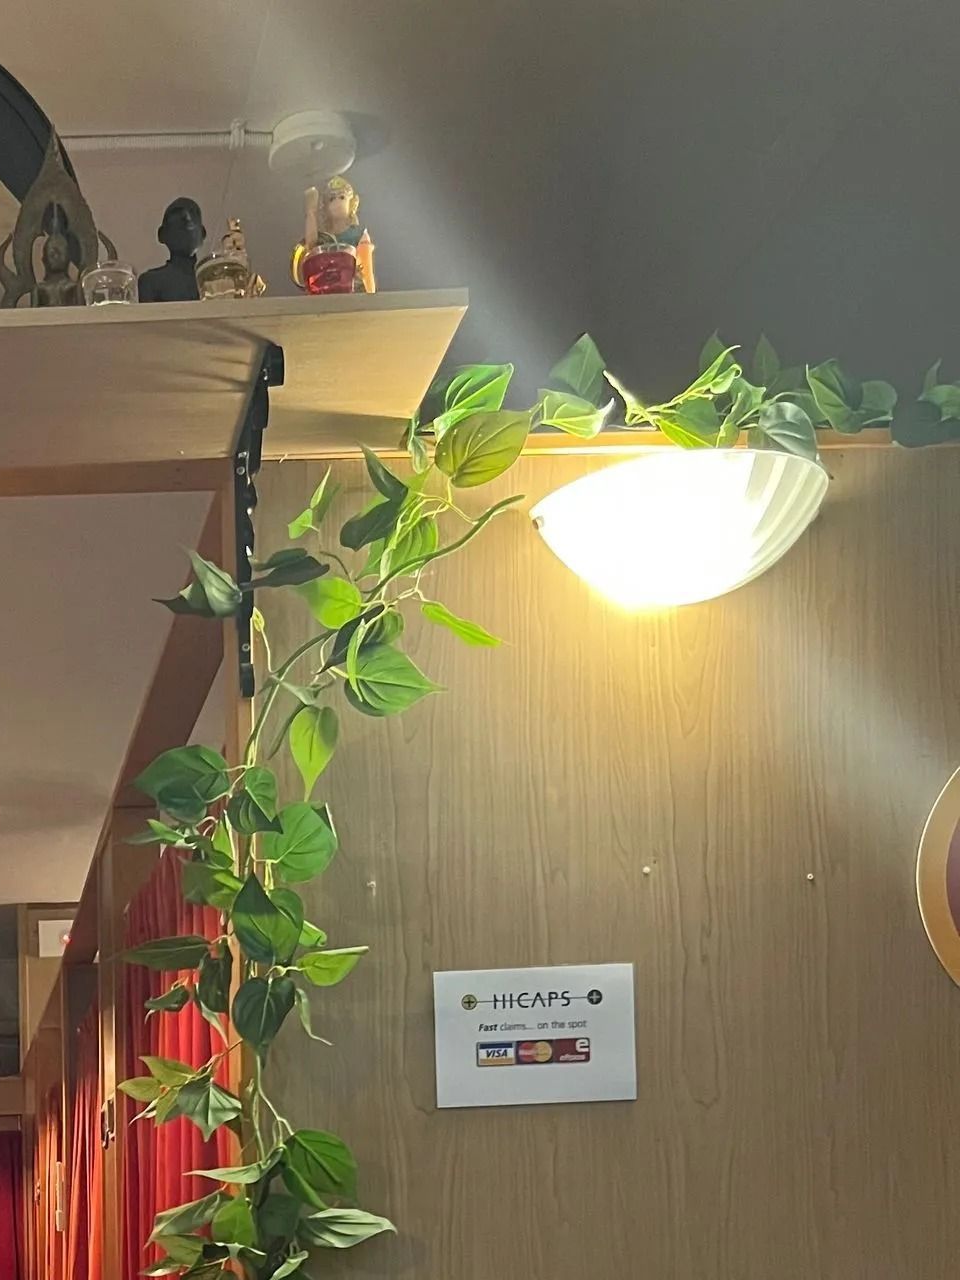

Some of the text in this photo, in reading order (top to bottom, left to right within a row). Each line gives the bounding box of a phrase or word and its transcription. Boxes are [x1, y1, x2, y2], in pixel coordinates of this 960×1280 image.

[493, 990, 571, 1009] HICAPS
[478, 1023, 497, 1032] Fast
[537, 1022, 548, 1030] on
[551, 1020, 565, 1029] the
[568, 1020, 587, 1031] spot
[486, 1049, 508, 1058] VISA
